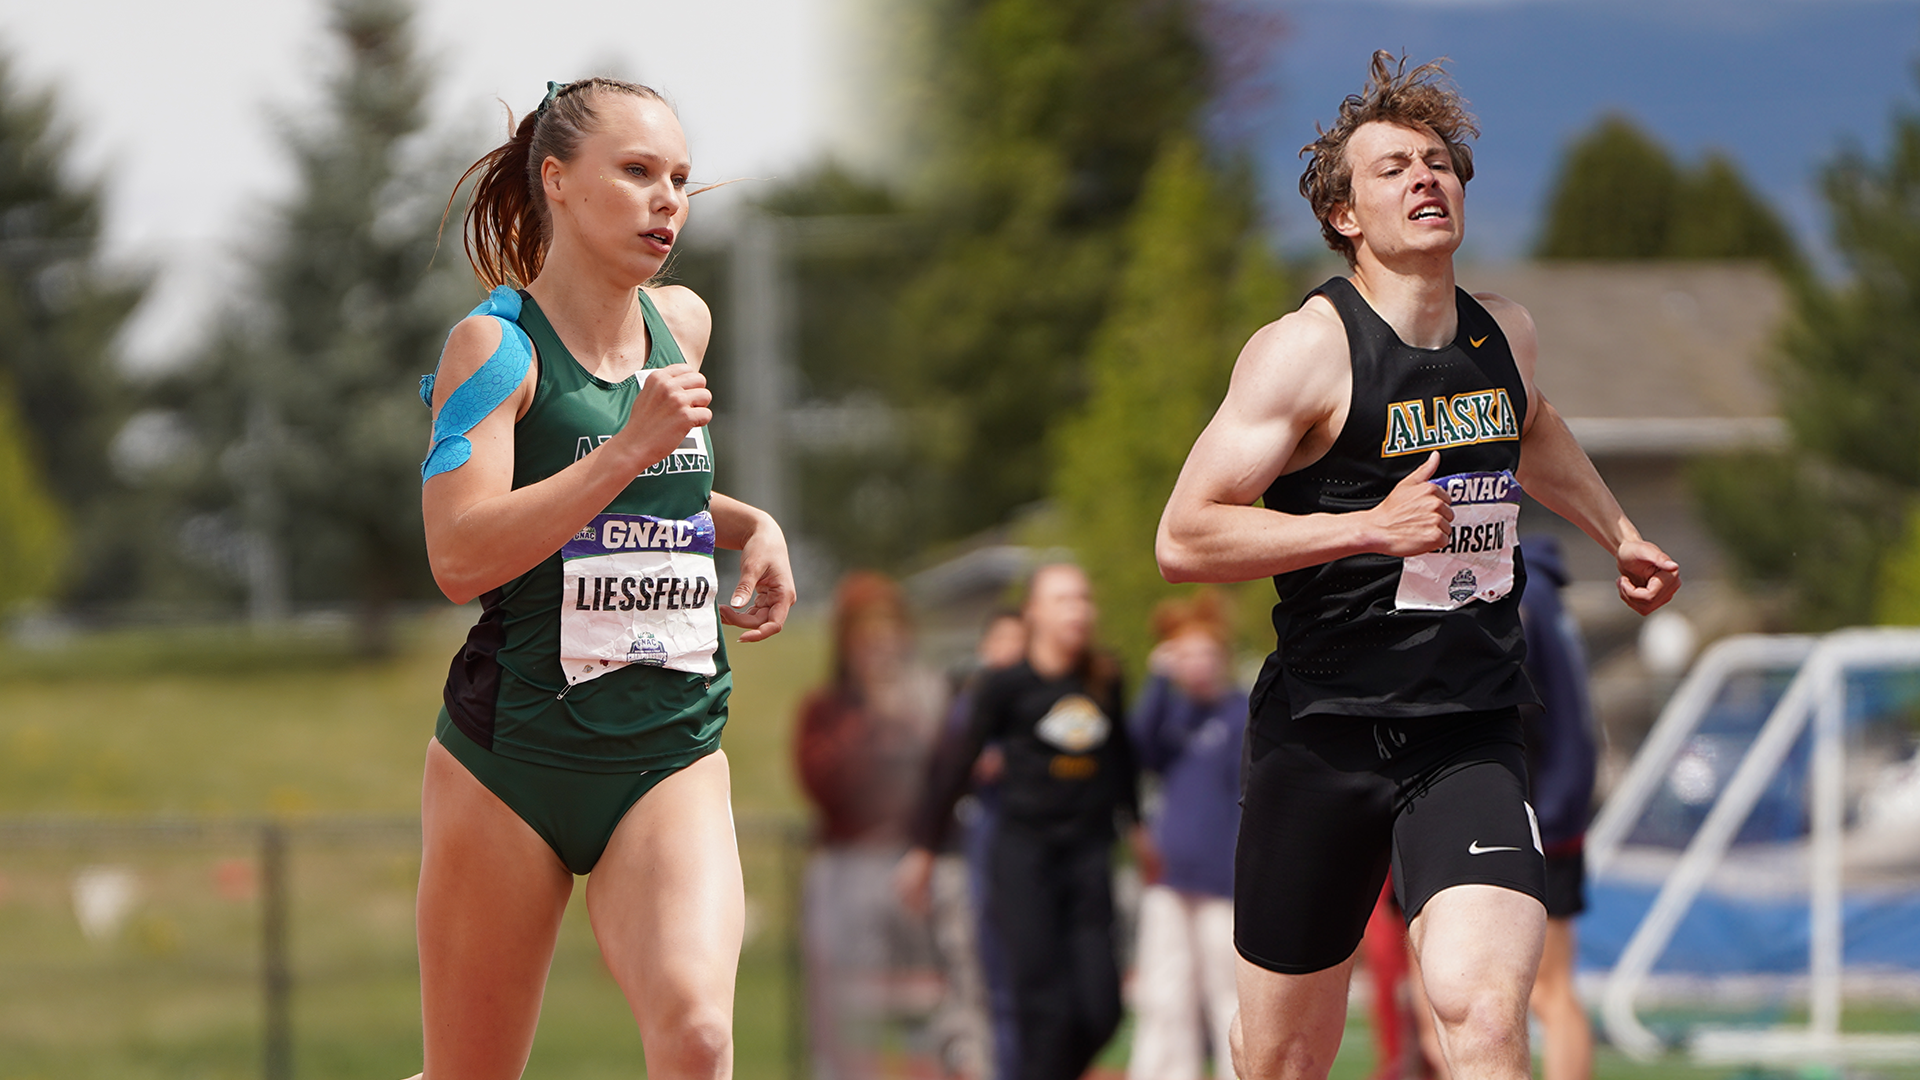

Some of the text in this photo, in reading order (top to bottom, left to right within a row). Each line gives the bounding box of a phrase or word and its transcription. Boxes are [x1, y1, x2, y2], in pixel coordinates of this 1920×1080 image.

[1383, 389, 1519, 456] ALASKA
[1447, 475, 1509, 502] GNAC
[573, 532, 596, 541] GNAC
[602, 520, 694, 549] GNAC
[1429, 521, 1504, 554] ARSEN
[575, 576, 710, 611] LIESSFELD
